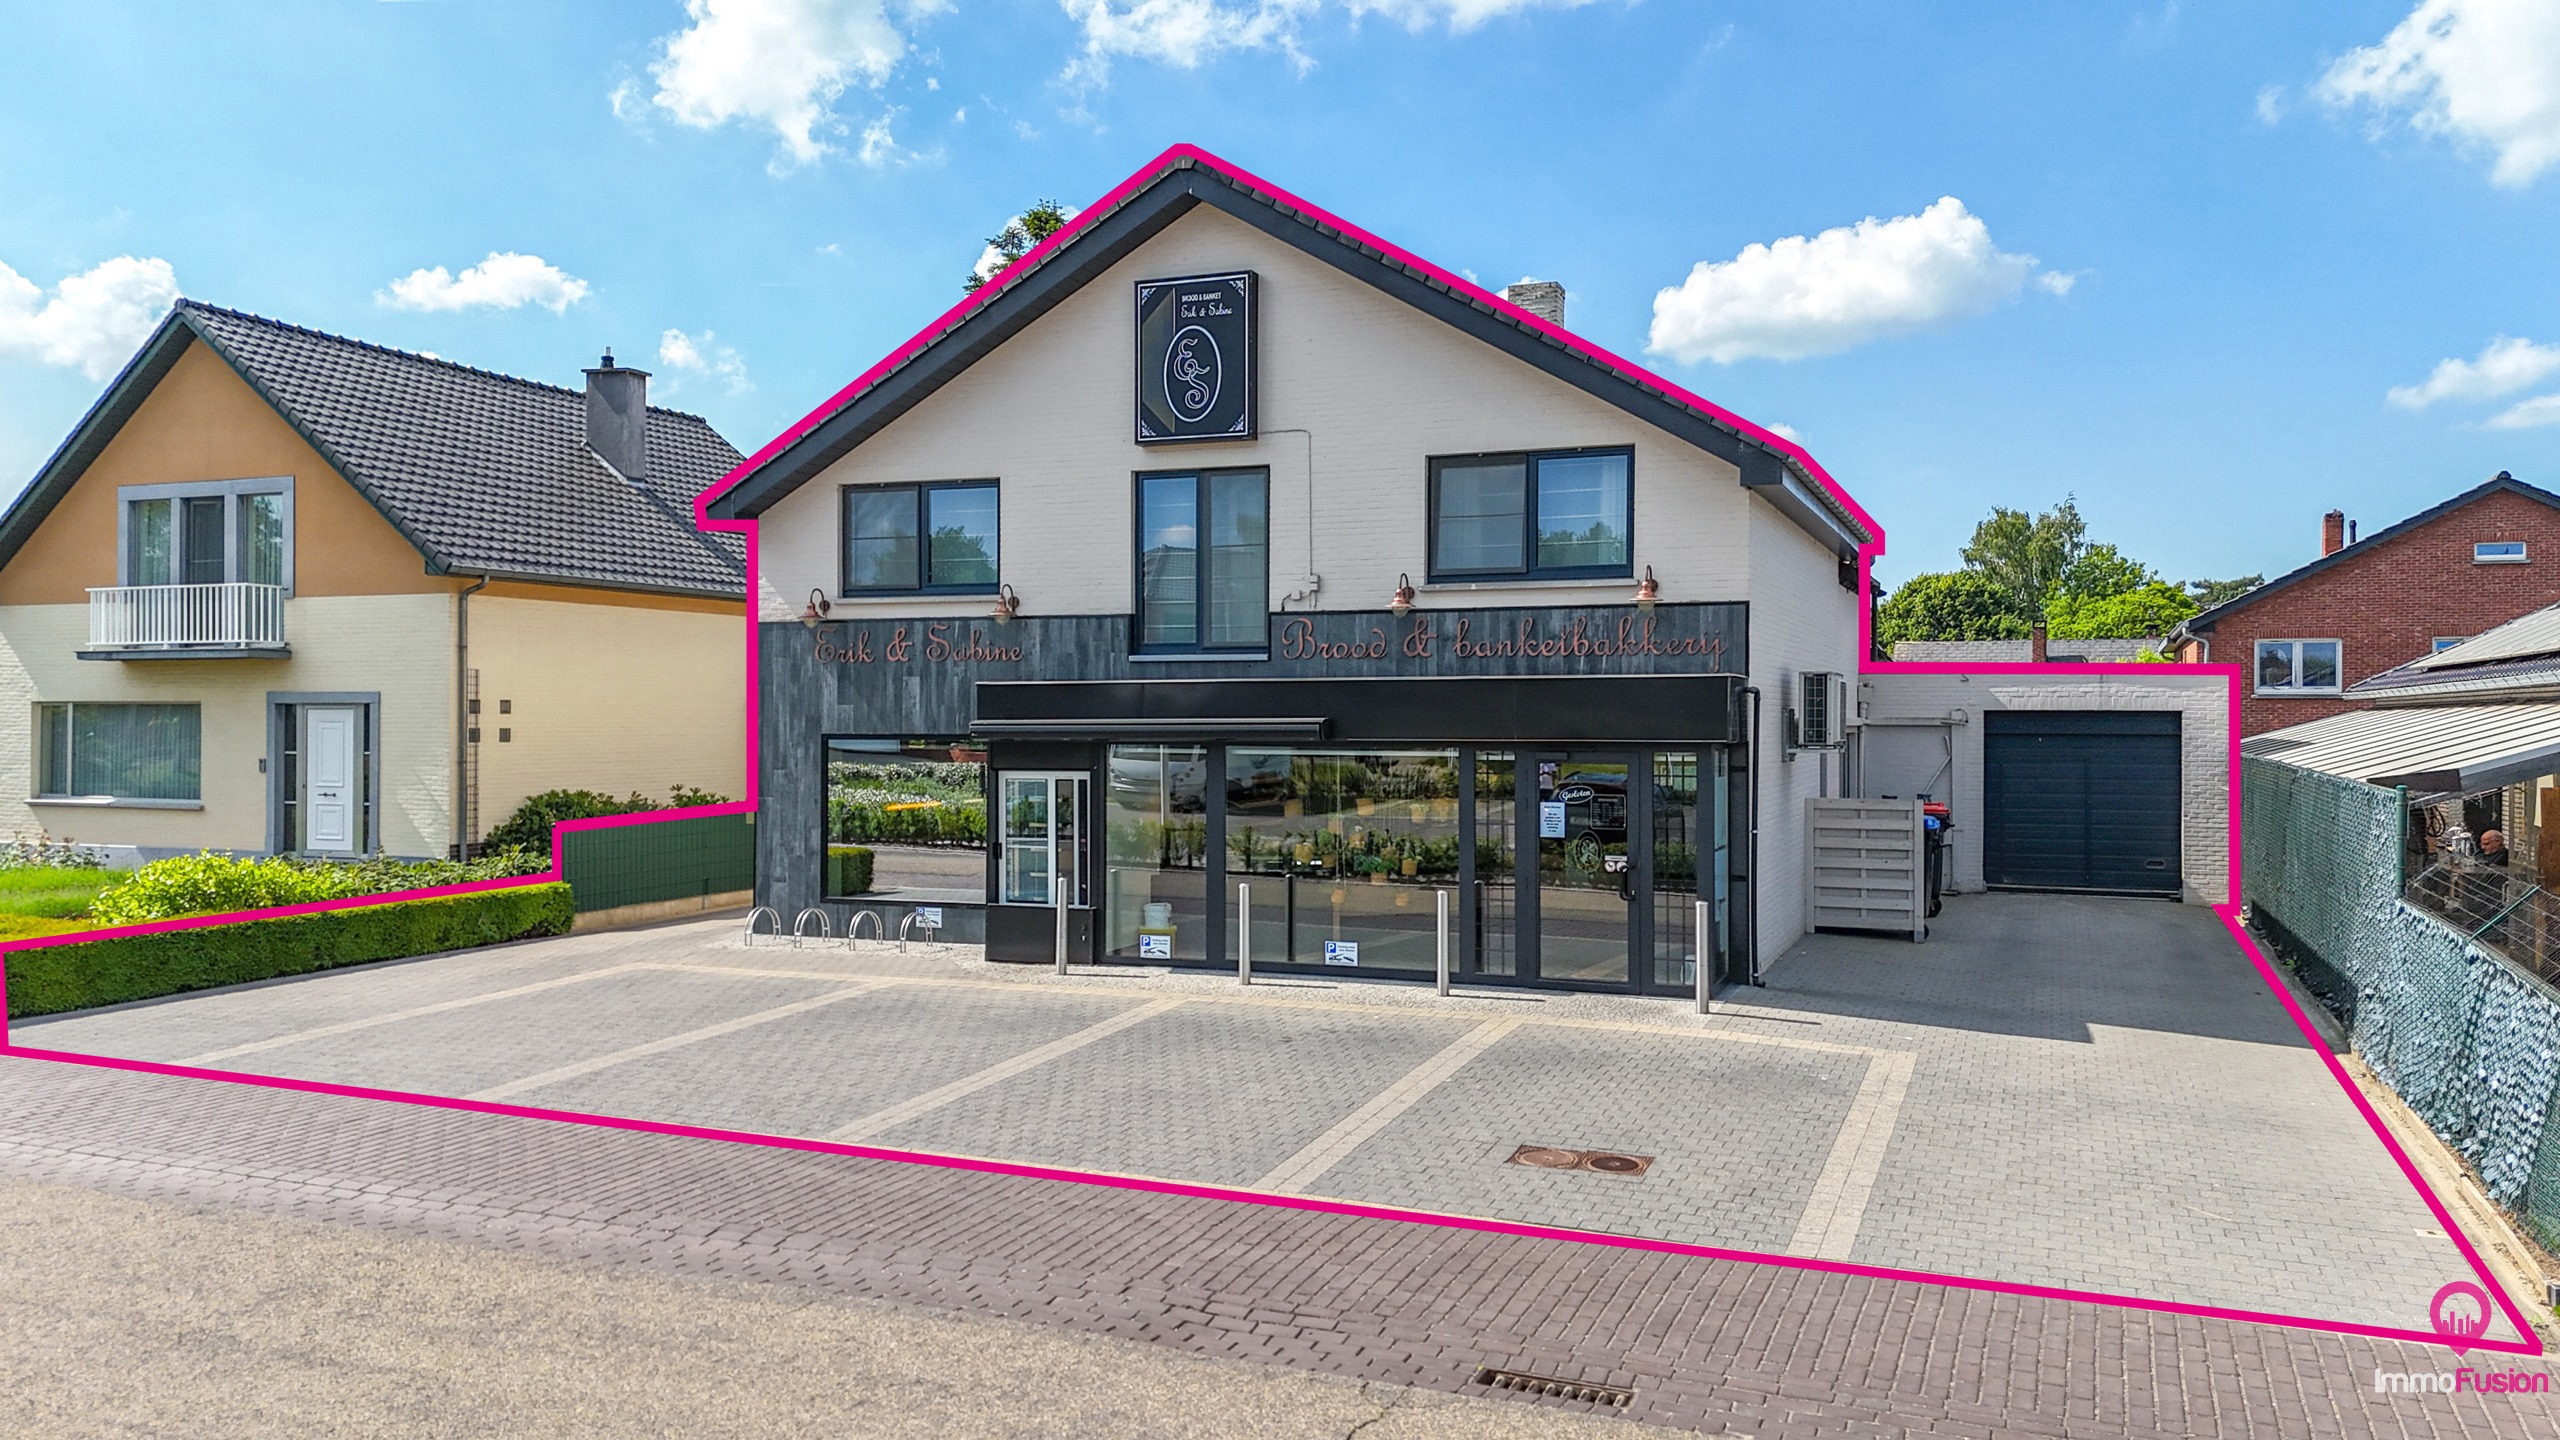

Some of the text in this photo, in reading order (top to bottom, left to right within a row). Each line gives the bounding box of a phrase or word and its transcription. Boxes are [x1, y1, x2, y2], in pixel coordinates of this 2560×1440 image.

[1181, 294, 1198, 303] BROOD
[1203, 292, 1222, 300] BANKET
[1181, 302, 1232, 318] Erik & Sabine
[814, 623, 1024, 664] Erik & Sabine
[1281, 615, 1727, 673] Brood & banketbakkerij
[1562, 790, 1591, 800] Gesloten
[1142, 936, 1150, 946] P
[1328, 943, 1336, 953] P
